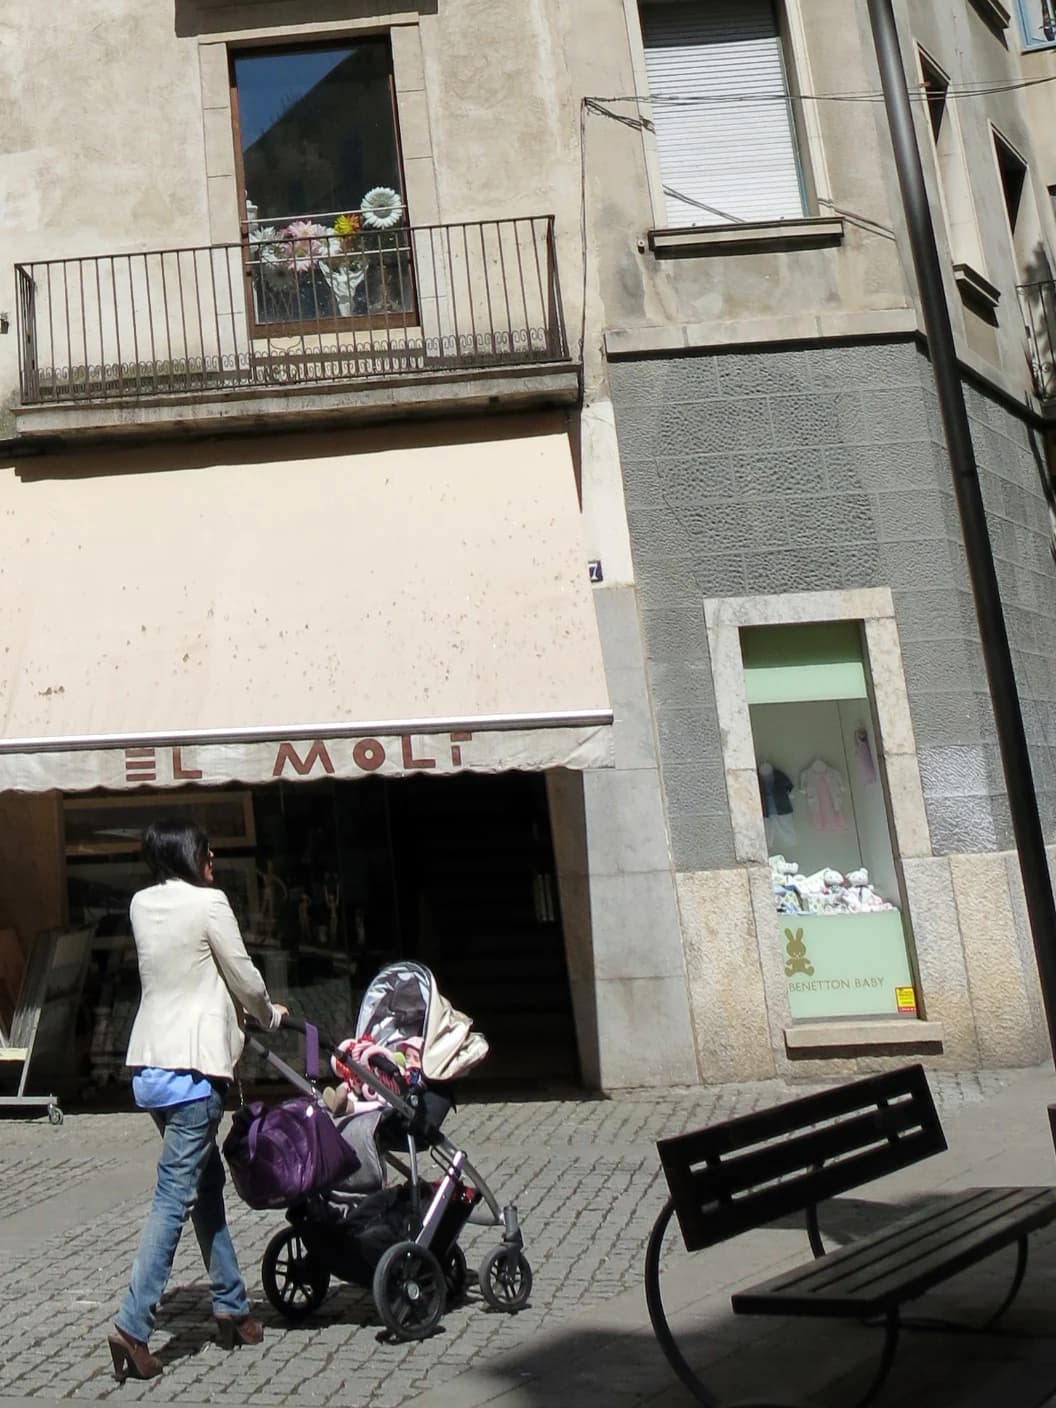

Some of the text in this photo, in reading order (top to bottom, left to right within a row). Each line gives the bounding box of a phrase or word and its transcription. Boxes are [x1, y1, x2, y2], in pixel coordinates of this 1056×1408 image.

[125, 746, 203, 782] EL
[788, 976, 885, 993] BENETTON BABY
